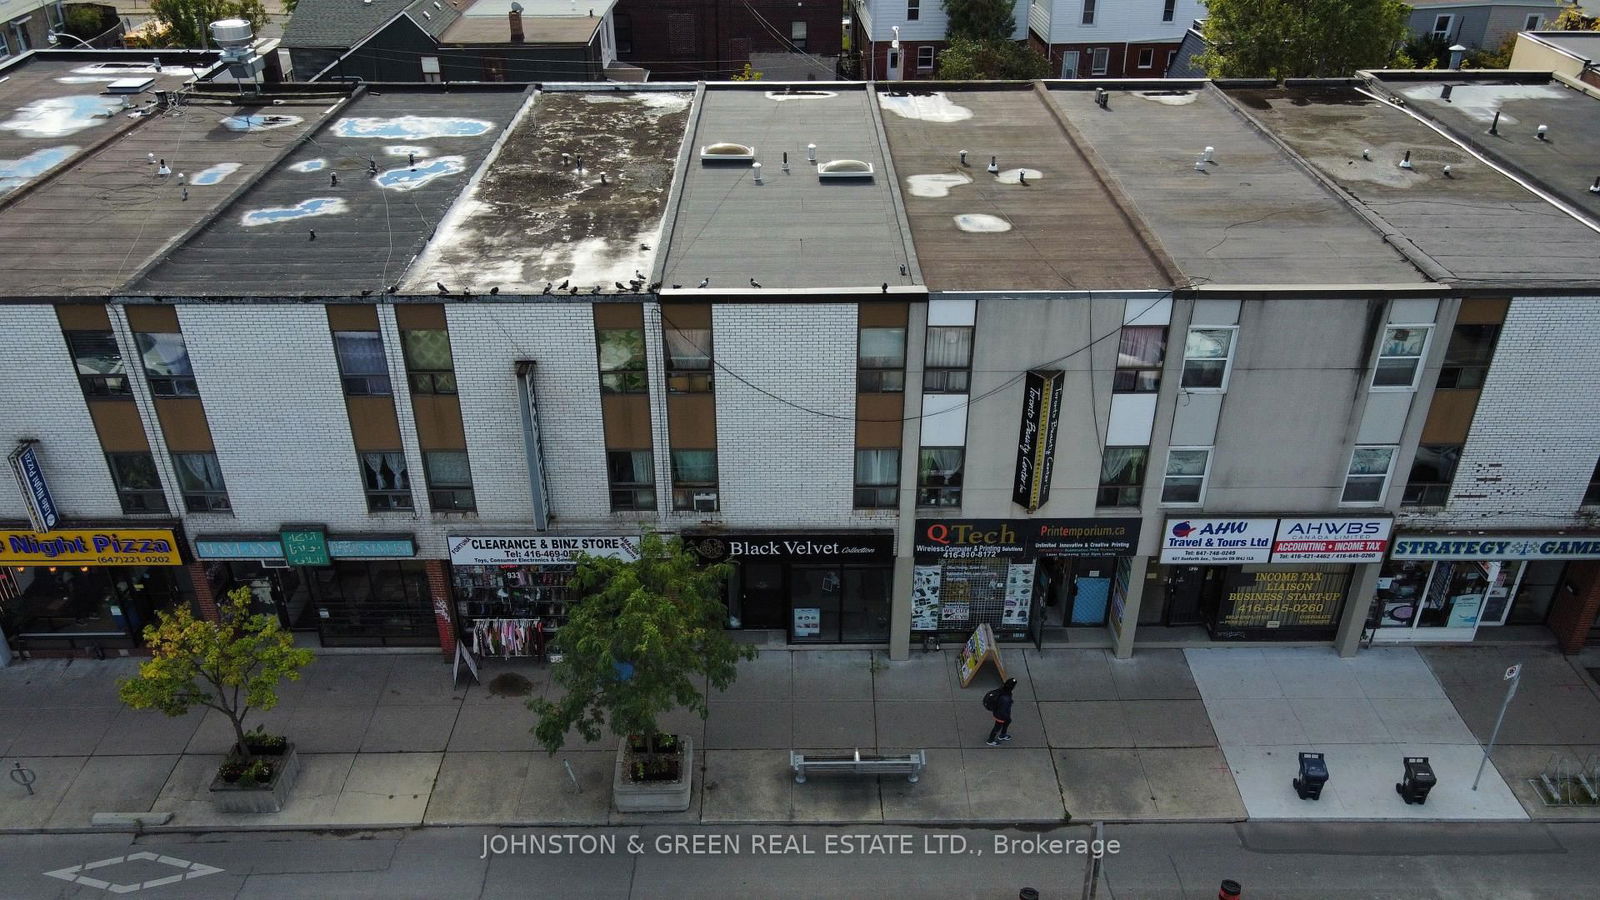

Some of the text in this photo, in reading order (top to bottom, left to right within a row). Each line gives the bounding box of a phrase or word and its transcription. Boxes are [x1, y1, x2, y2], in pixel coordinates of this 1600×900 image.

[1040, 525, 1126, 538] Printemporium.ca
[1199, 521, 1248, 535] AHW
[1287, 522, 1381, 534] AHWBS
[9, 534, 89, 558] Night
[92, 534, 172, 554] Pizza
[471, 539, 620, 550] CLEARANCE & BINZ STORE
[1169, 537, 1269, 547] Travel & Tours Ltd
[1277, 542, 1382, 551] ACCOUNTING INCOME TAX
[729, 541, 780, 555] Black
[784, 541, 840, 555] Velvet
[979, 545, 1001, 553] Printing
[1395, 541, 1511, 554] STRATEGY
[504, 550, 521, 558] Tel:
[97, 556, 170, 564] (647)221-0202
[1255, 572, 1324, 581] INCOME TAX
[1267, 582, 1313, 591] LIAISON
[1228, 592, 1340, 601] BUSINESS START-UP
[1238, 603, 1324, 613] 416-645-0260
